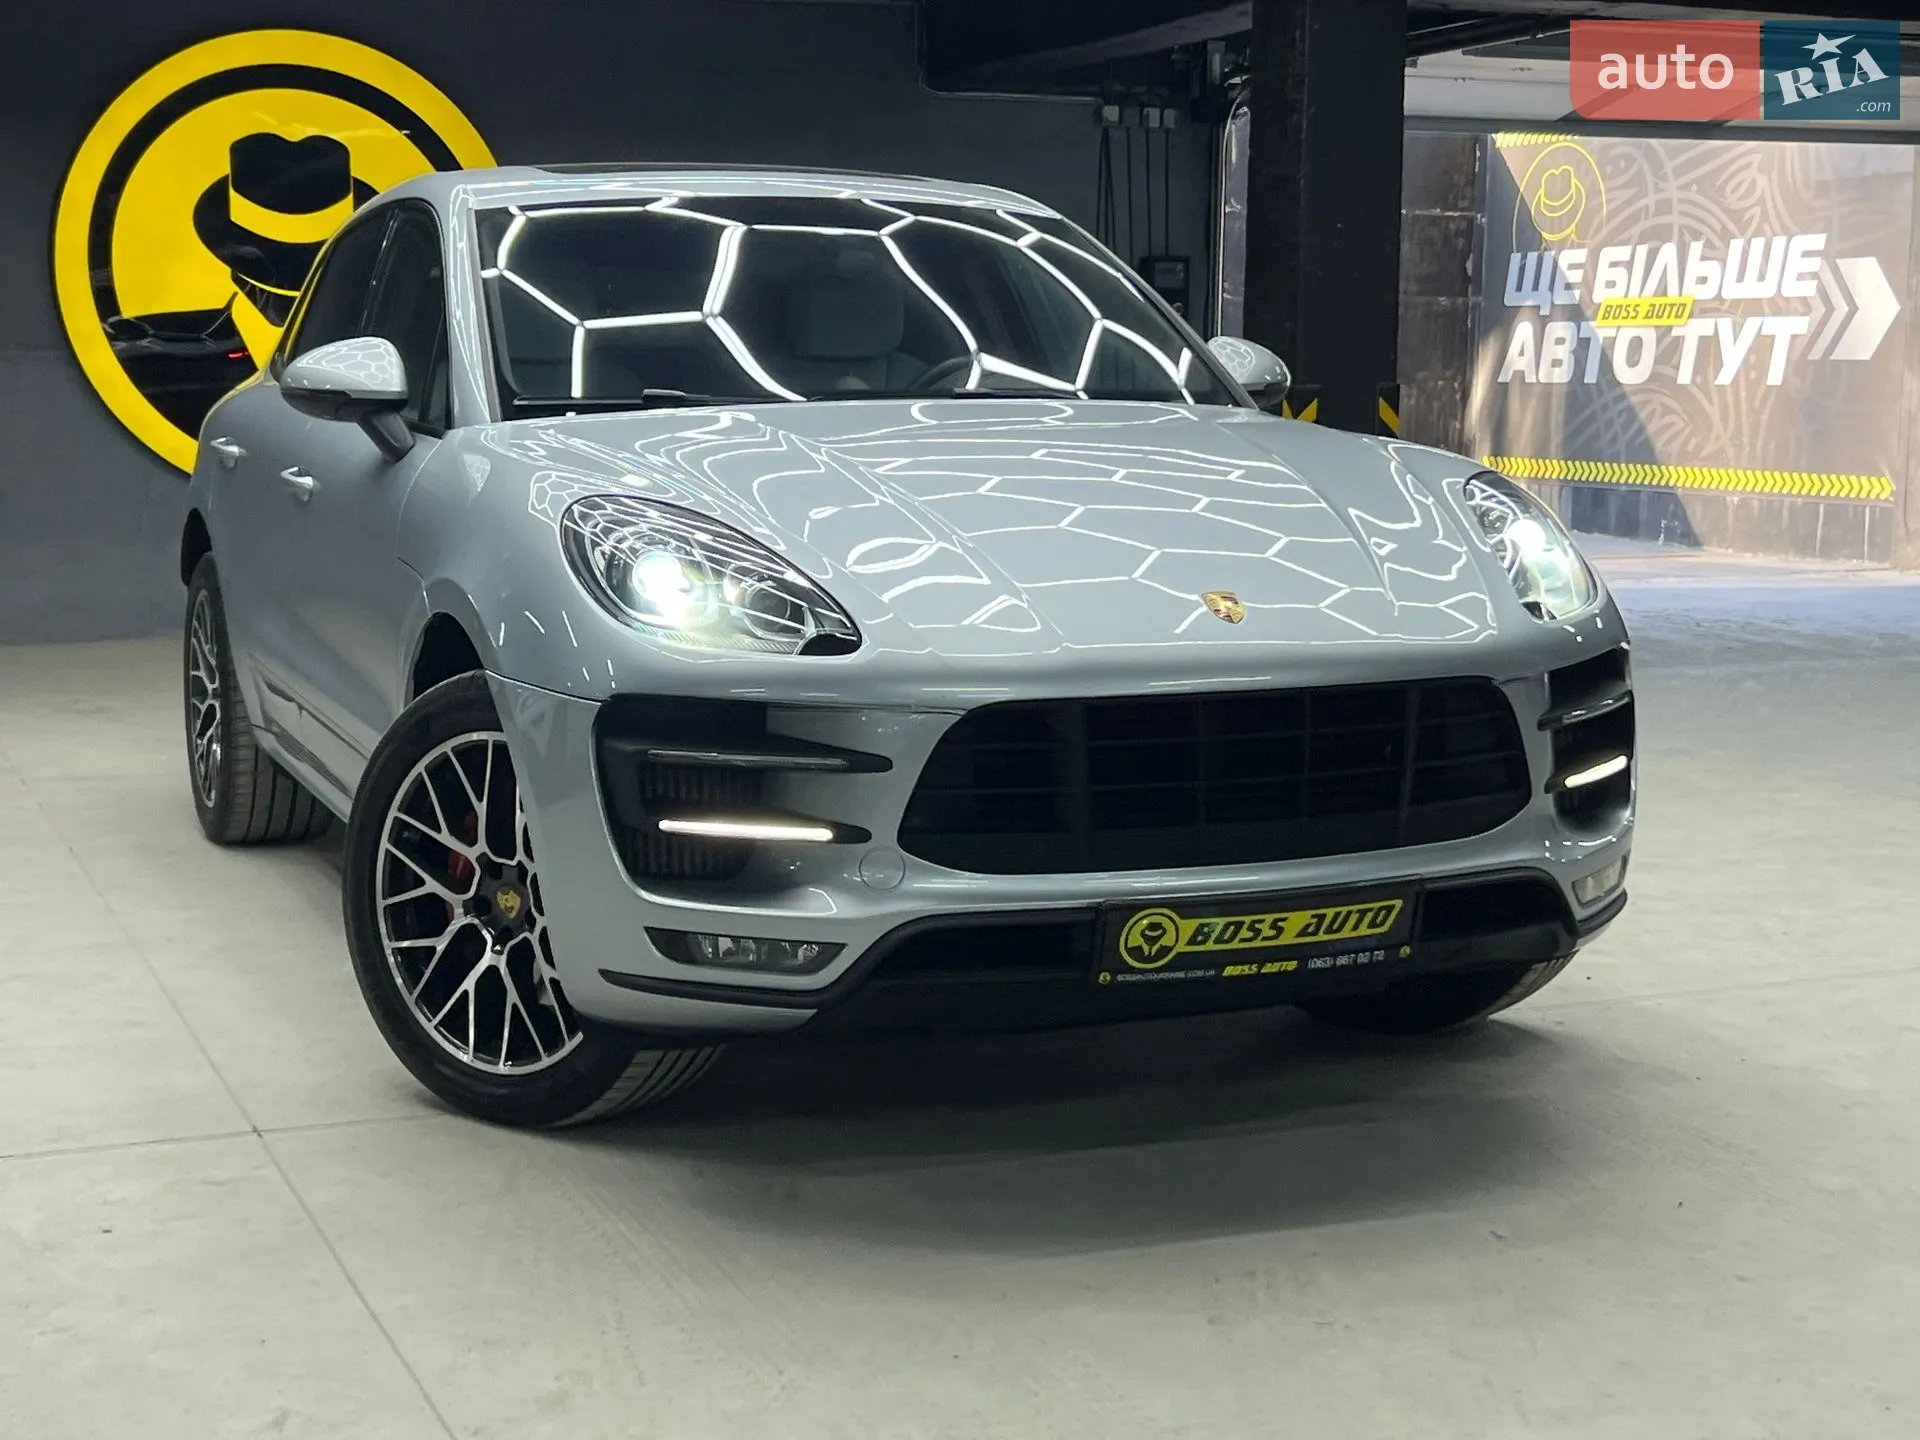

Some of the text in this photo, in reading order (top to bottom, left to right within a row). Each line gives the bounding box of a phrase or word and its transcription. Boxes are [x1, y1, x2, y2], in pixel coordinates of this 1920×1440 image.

[1503, 233, 1827, 316] ЩЕ БІЛЬШЕ
[1601, 302, 1688, 321] BOSS AUTO
[1497, 315, 1810, 386] АВТО ТУТ
[1184, 904, 1397, 946] BOSS AUTO
[1222, 964, 1259, 977] BOSS
[1260, 960, 1298, 974] AUTO
